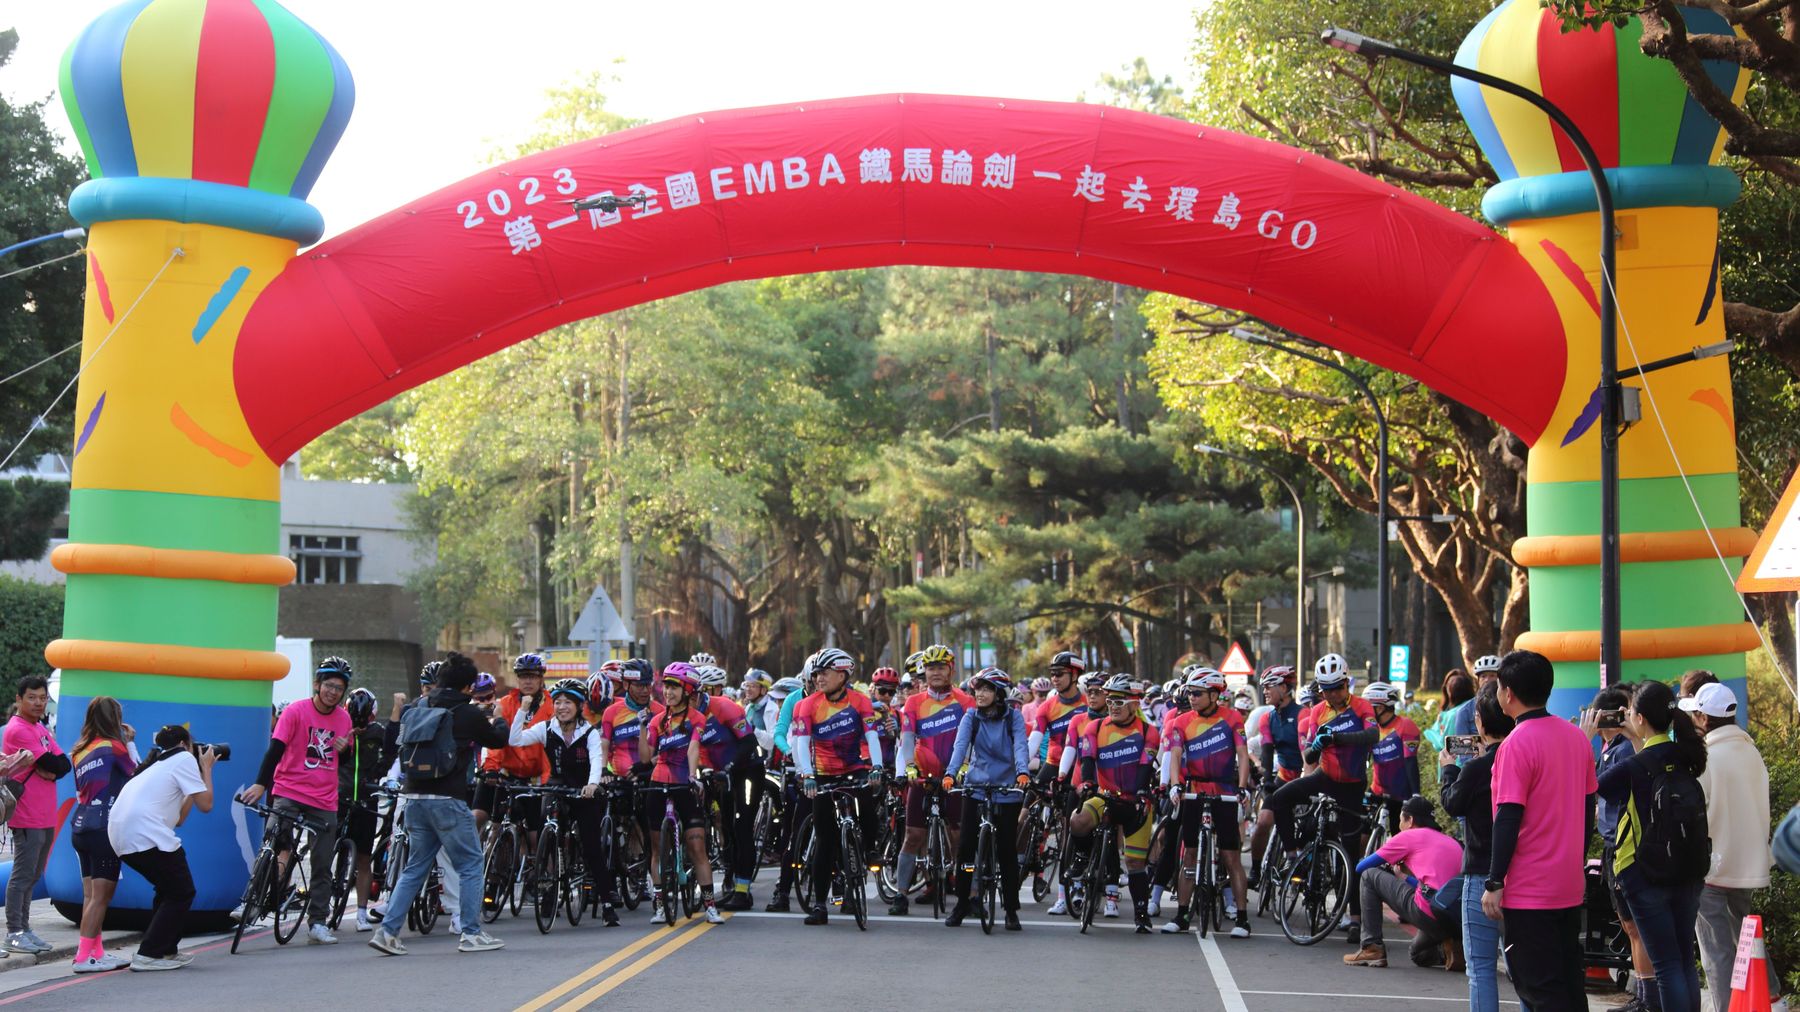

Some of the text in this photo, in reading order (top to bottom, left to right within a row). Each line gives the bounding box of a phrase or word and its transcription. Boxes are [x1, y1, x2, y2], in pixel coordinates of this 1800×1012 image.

[458, 168, 577, 229] 2023
[1391, 647, 1406, 669] P
[832, 717, 853, 729] EMBA
[935, 714, 956, 727] EMBA
[1203, 732, 1226, 748] EMBA
[1114, 745, 1138, 758] EMBA
[81, 758, 103, 774] EMBA
